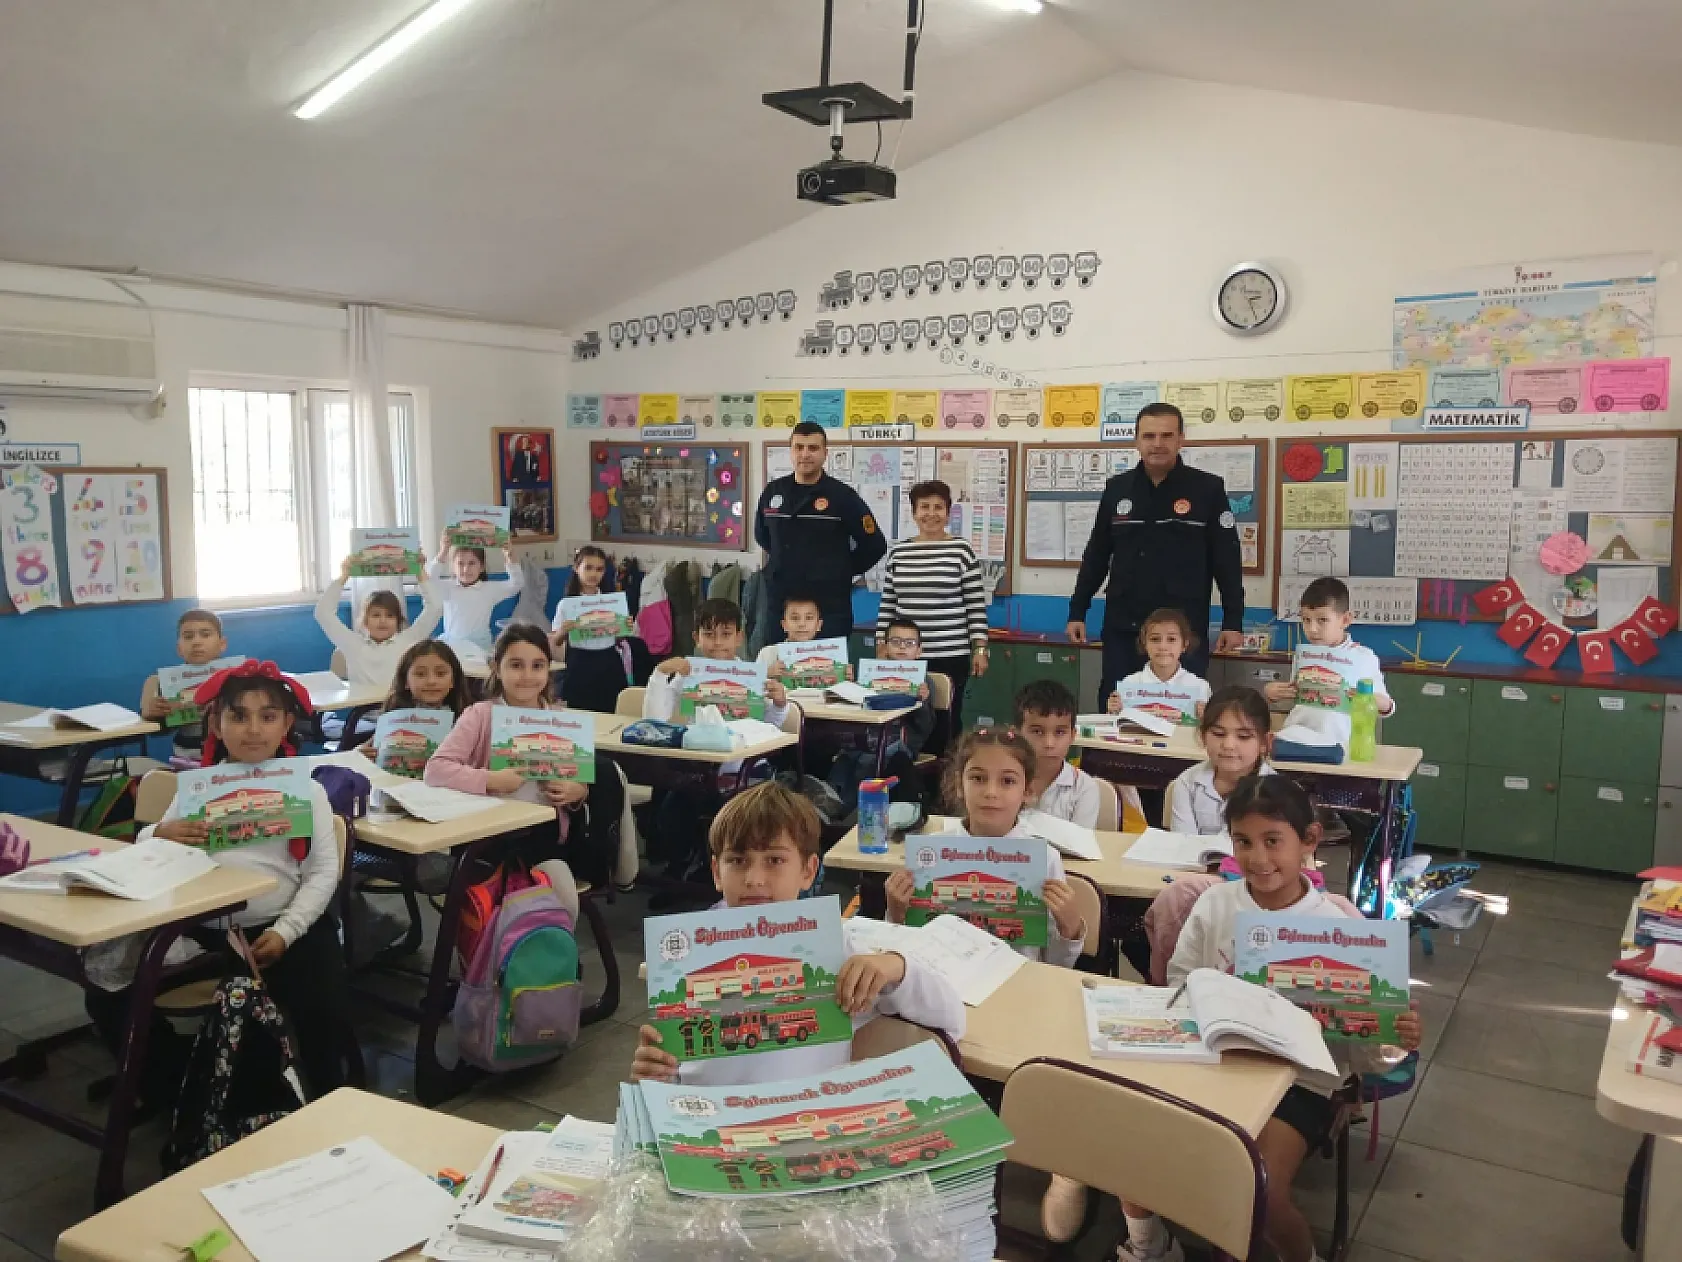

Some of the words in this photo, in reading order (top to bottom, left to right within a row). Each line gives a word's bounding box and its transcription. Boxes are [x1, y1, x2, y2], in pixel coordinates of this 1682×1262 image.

[1429, 410, 1520, 426] MATEMATİK
[1105, 427, 1135, 437] HAYA
[3, 448, 62, 461] İNGİLİZCE
[11, 486, 39, 523] 3
[119, 479, 148, 516] 5
[16, 546, 49, 586] 8
